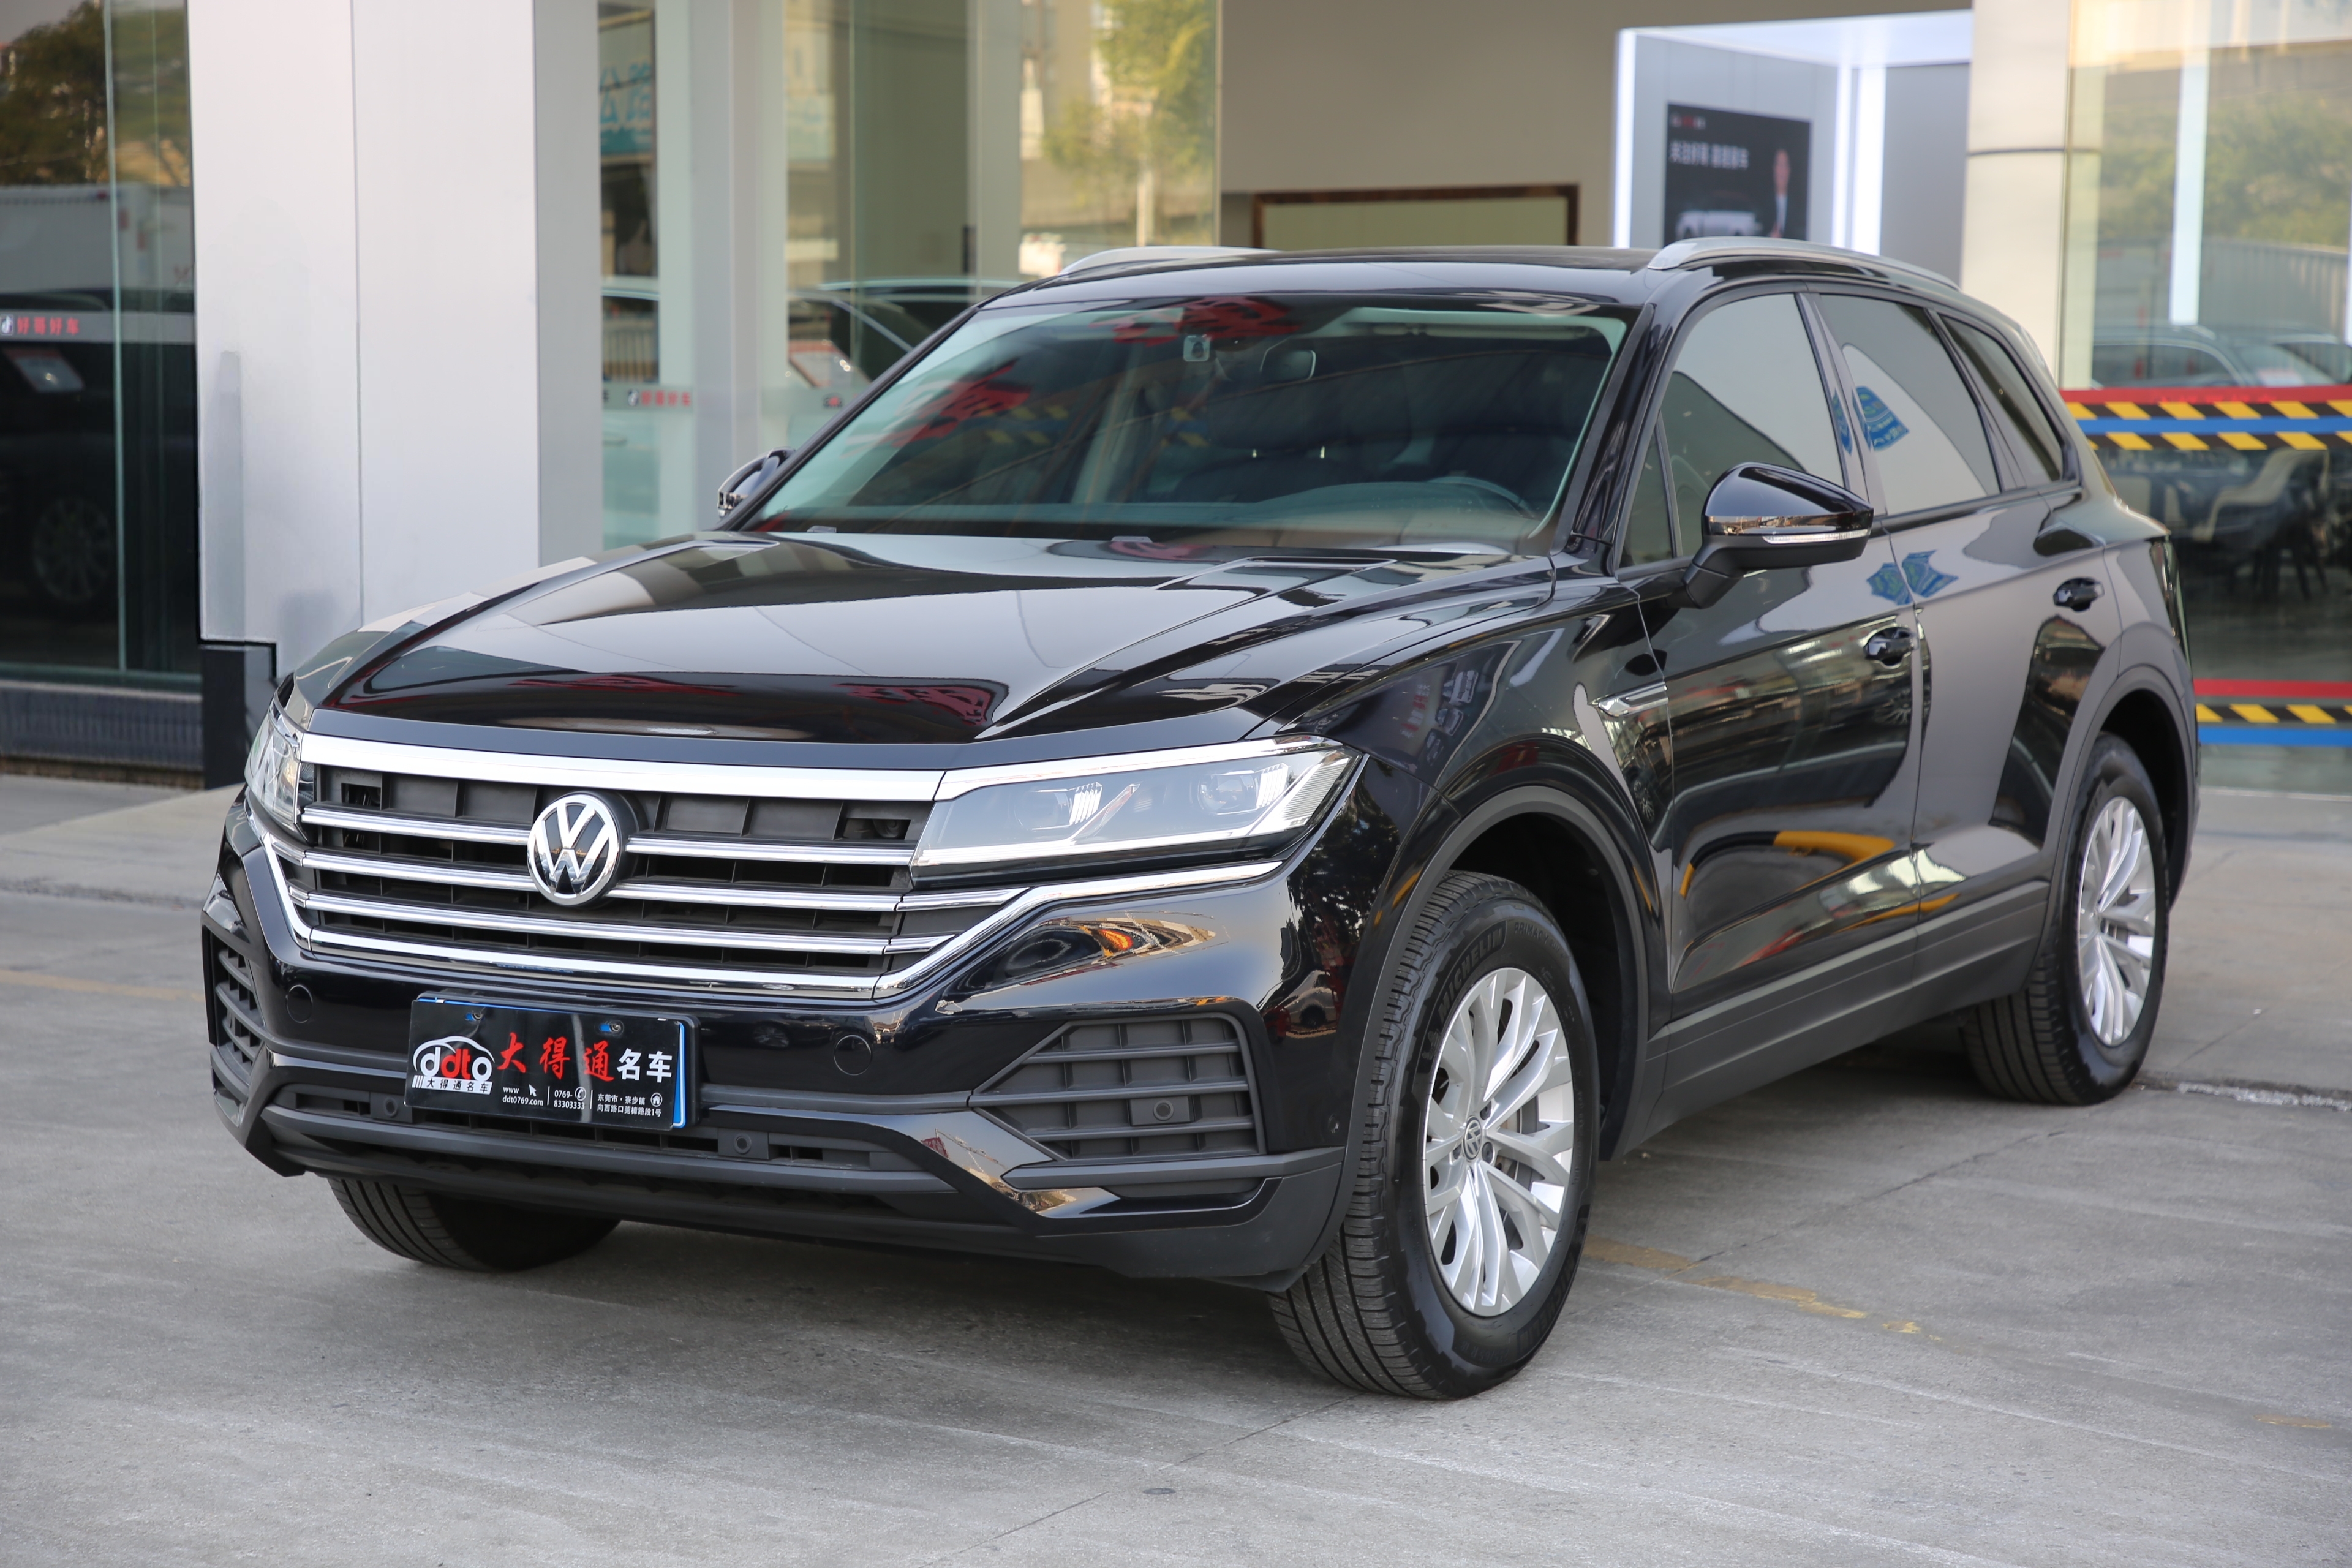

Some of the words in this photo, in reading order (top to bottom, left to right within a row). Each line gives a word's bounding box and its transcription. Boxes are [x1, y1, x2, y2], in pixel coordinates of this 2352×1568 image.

[1514, 921, 1549, 945] PRIMACY
[1438, 925, 1503, 1025] MICHELIN
[426, 1077, 489, 1093] 大得通名车
[502, 1095, 543, 1106] ddt0769.com
[554, 1100, 585, 1110] 83303333
